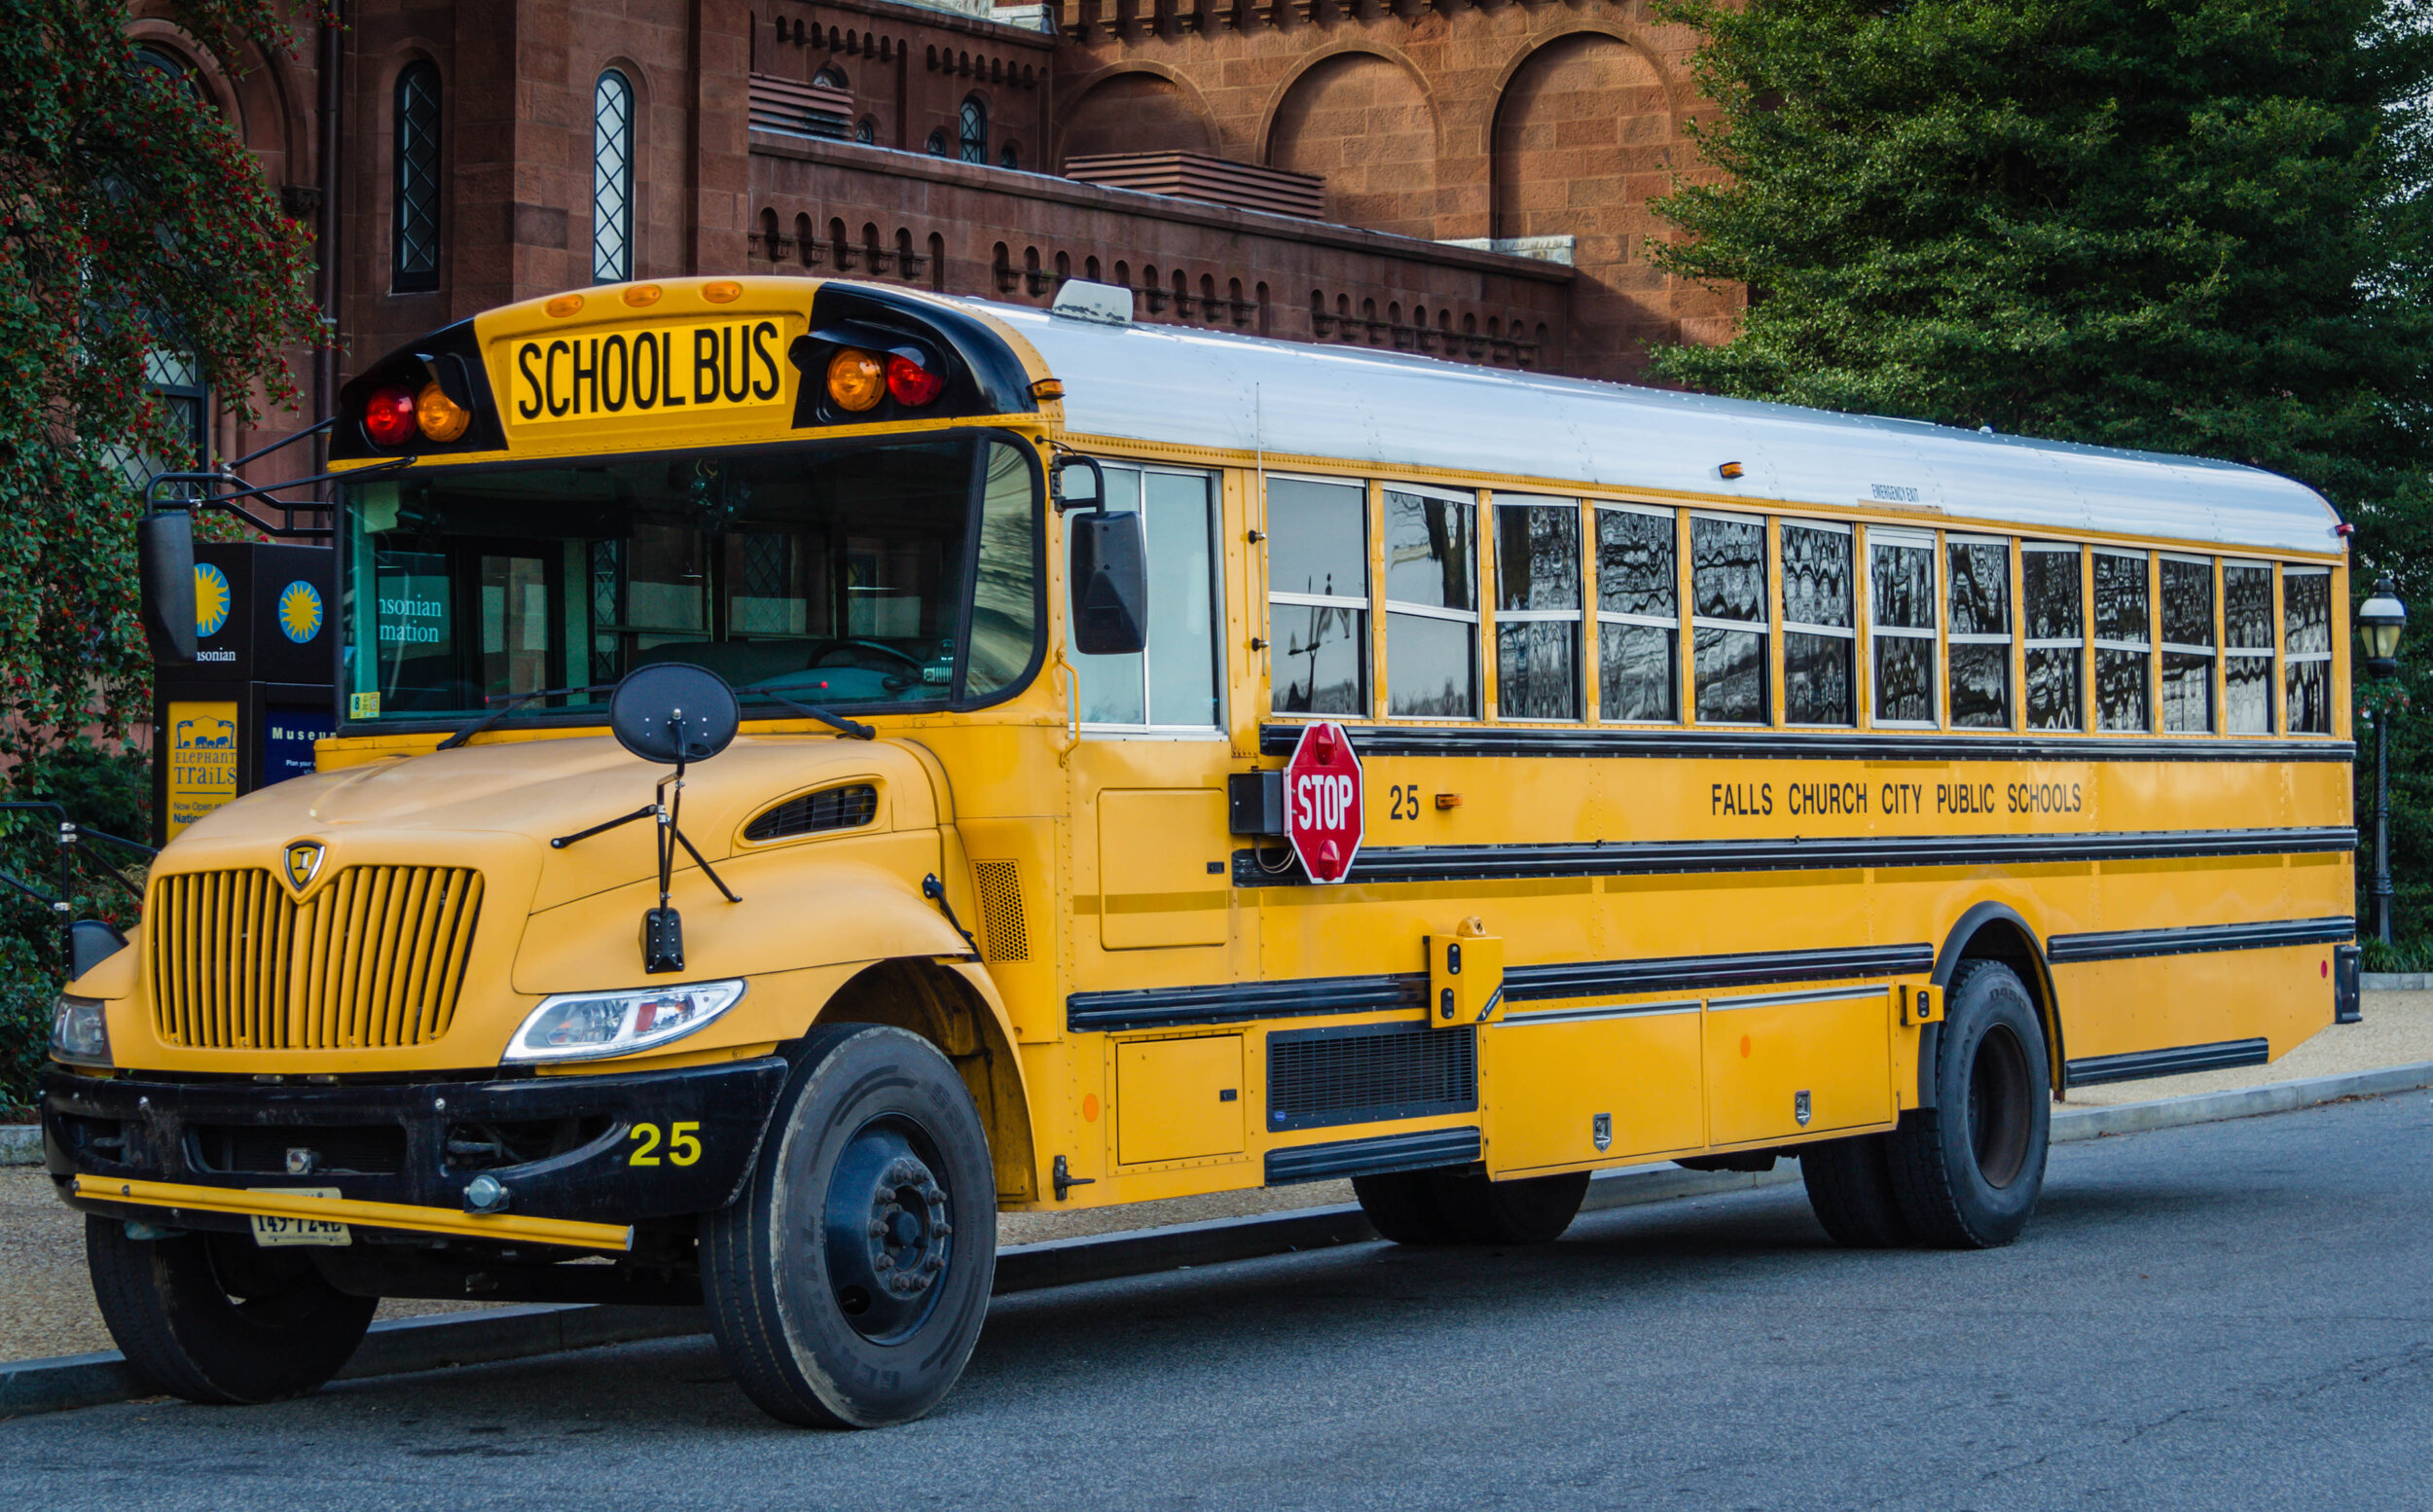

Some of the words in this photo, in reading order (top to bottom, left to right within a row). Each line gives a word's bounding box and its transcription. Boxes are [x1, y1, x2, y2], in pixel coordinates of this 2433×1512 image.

[519, 331, 686, 419] SCHOOL
[694, 320, 779, 405] BUS
[1871, 484, 1906, 501] EMERGENCY
[1906, 487, 1920, 503] EXIT
[173, 801, 191, 810] Now
[192, 801, 213, 812] Open
[1297, 774, 1354, 831] STOP
[1390, 784, 1420, 820] 25
[1711, 783, 1773, 816] FALLS
[1789, 782, 1868, 815] CHURCH
[1881, 782, 1923, 814] CITY
[1937, 783, 1995, 814] PUBLIC
[2008, 782, 2082, 813] SCHOOLS
[629, 1121, 703, 1167] 25
